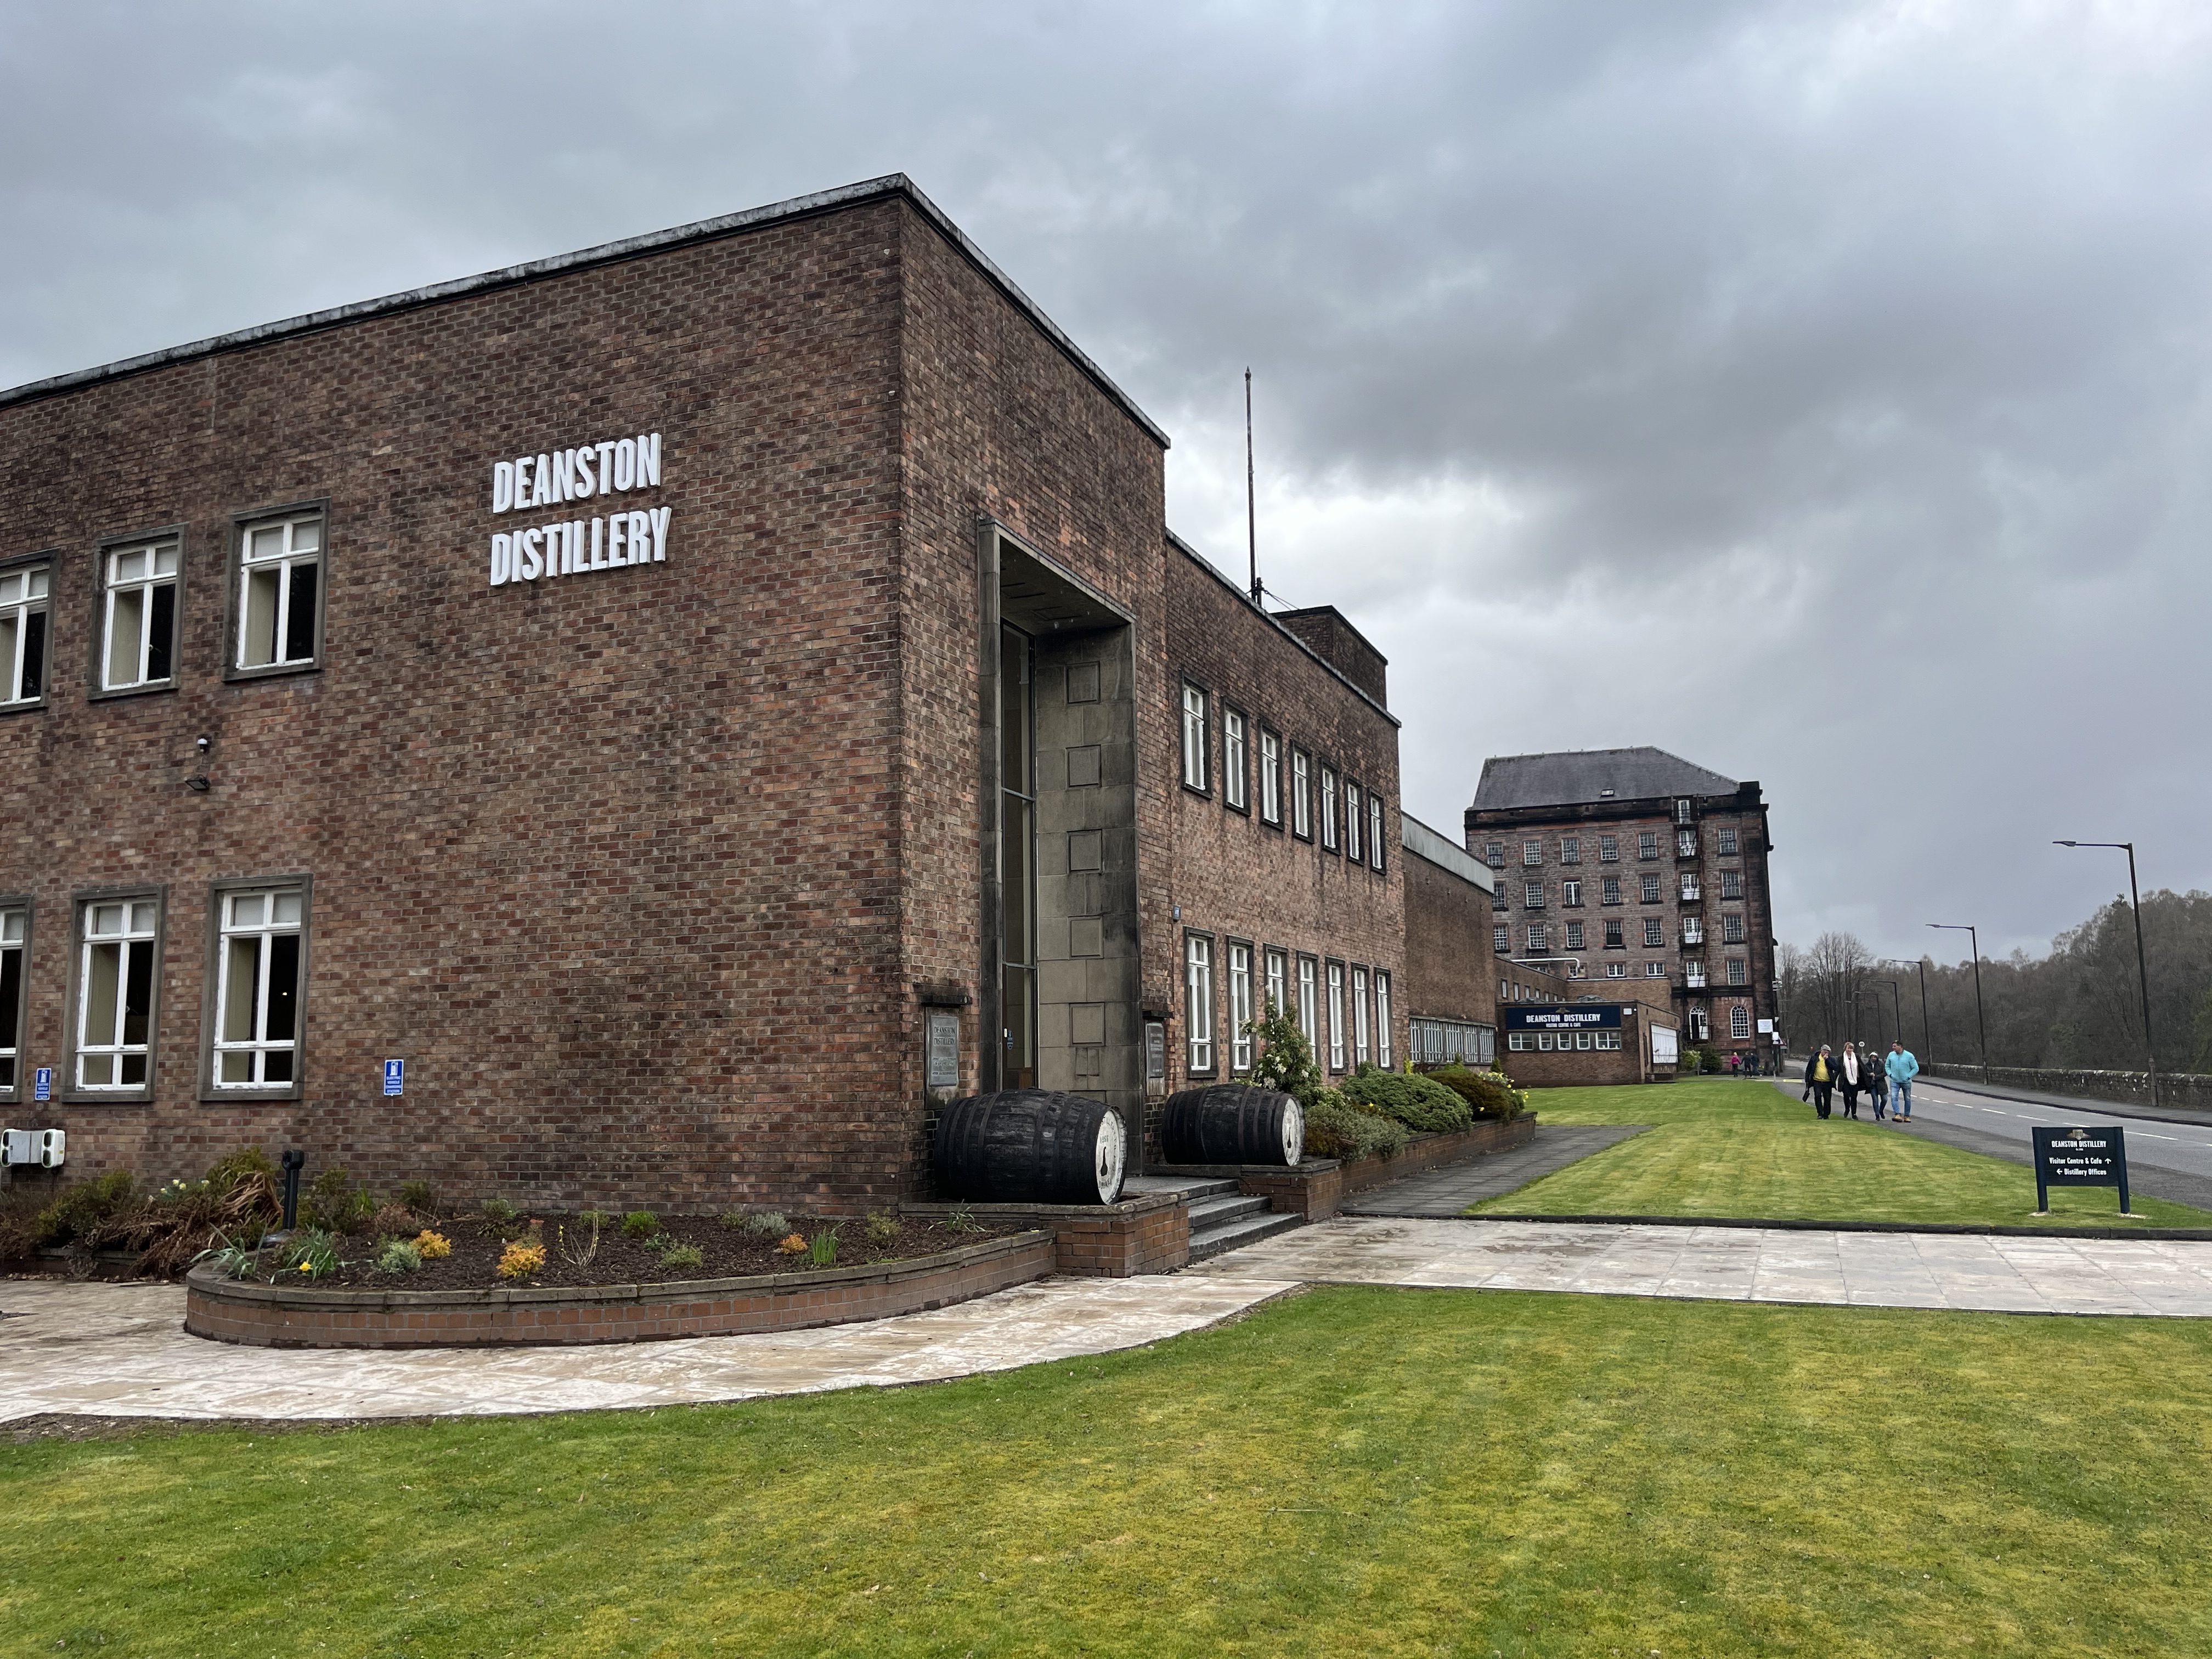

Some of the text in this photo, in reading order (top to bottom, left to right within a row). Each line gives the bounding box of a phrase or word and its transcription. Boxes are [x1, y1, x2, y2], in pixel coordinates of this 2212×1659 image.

[493, 433, 662, 514] DEANSTON
[490, 506, 672, 586] DISTILLERY
[1564, 1014, 1601, 1022] DISTILLERY
[934, 1026, 955, 1034] DEANSTON
[2064, 1168, 2087, 1177] Distillery
